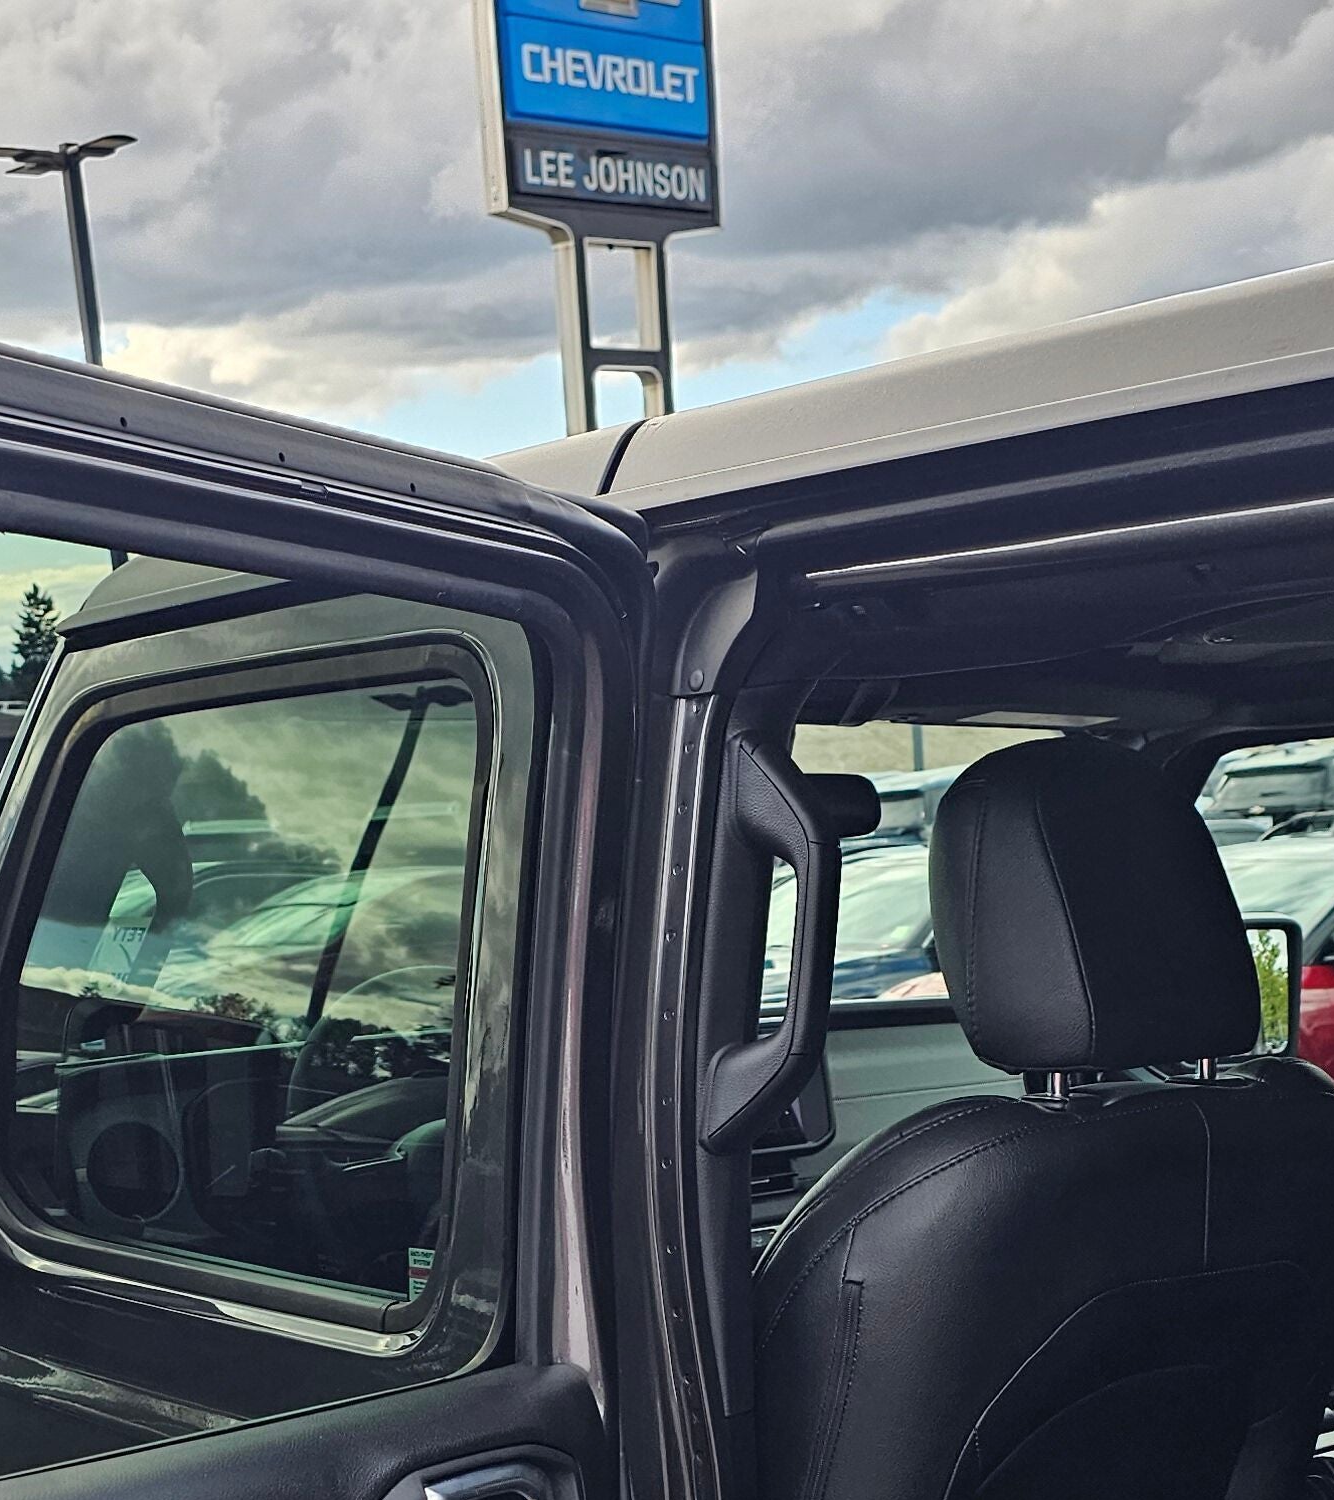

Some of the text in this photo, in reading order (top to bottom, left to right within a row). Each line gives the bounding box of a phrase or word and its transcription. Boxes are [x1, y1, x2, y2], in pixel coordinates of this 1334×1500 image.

[521, 43, 699, 103] CHEVROLET
[523, 149, 706, 201] LEE JOHNSON
